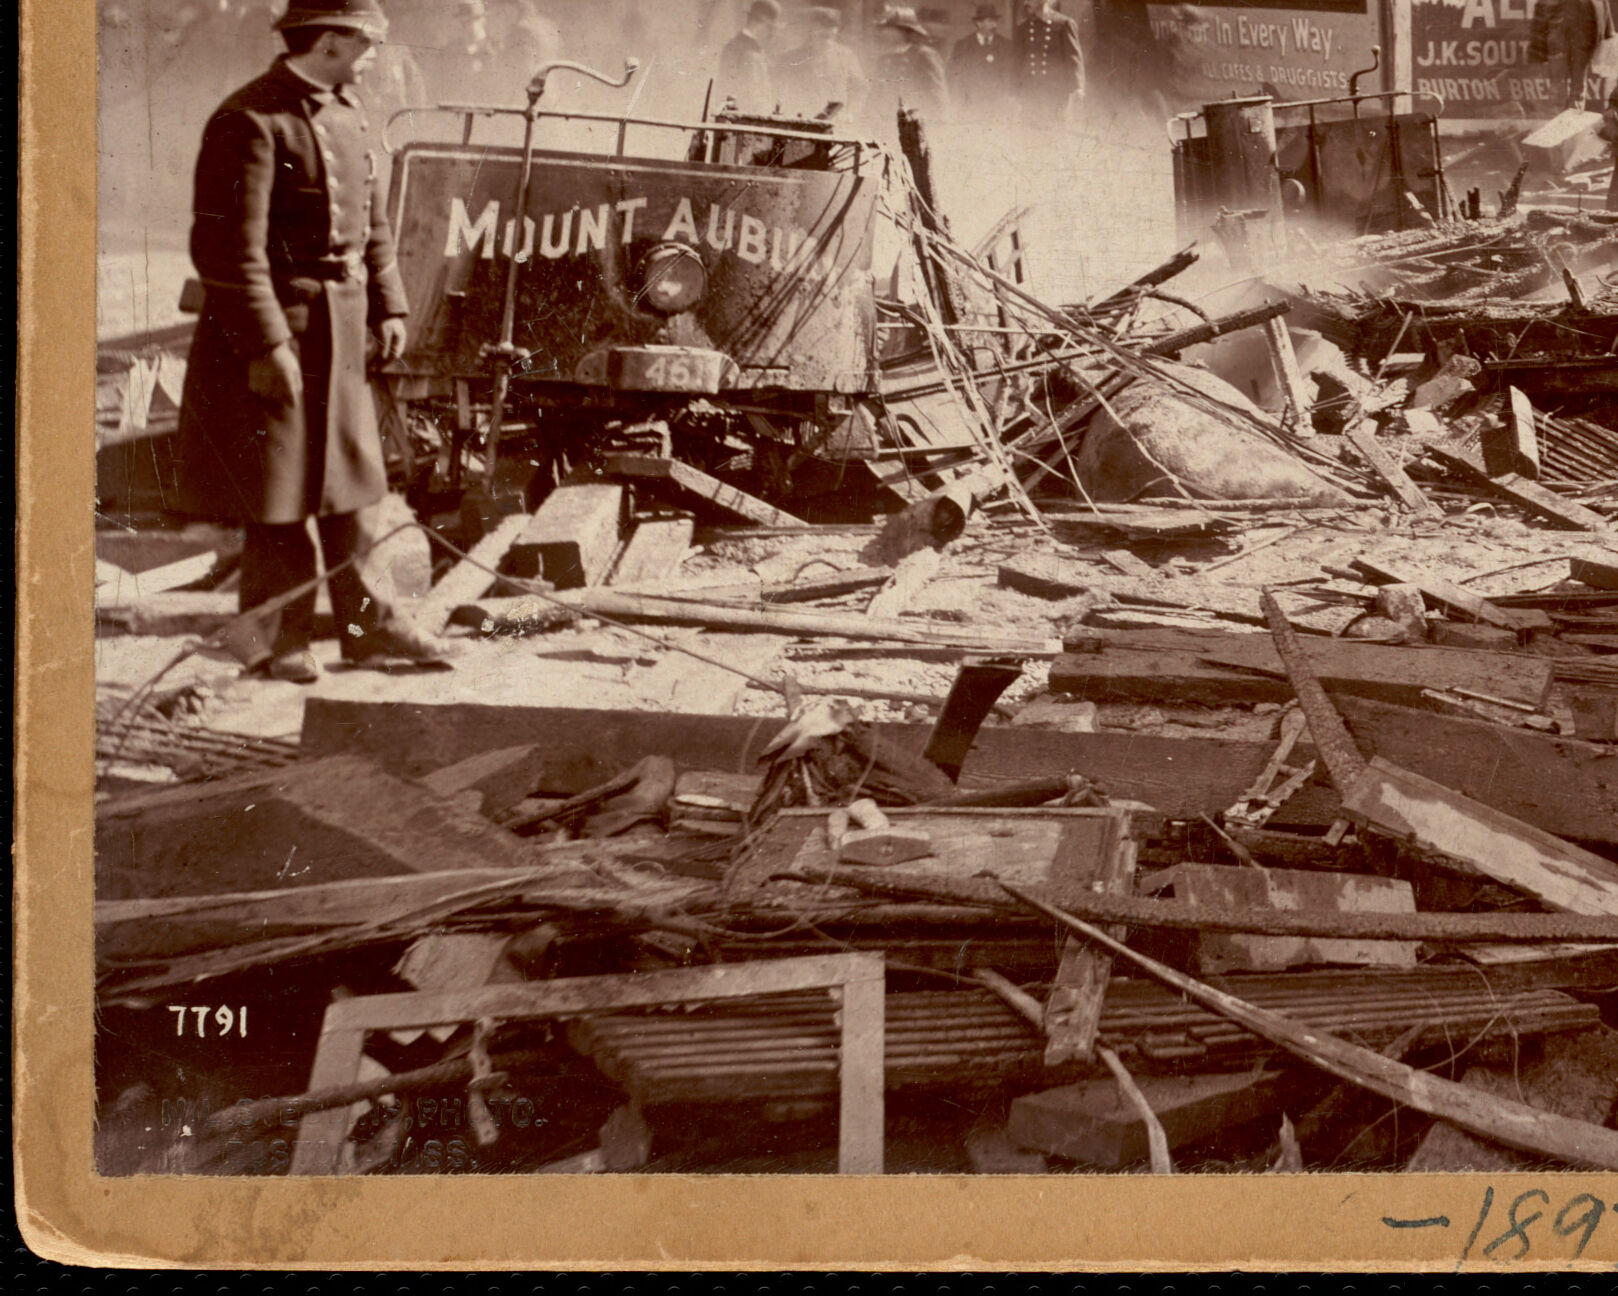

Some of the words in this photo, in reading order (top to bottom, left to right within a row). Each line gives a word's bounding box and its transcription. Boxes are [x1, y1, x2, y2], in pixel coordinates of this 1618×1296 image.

[1215, 14, 1233, 46] In
[1237, 14, 1289, 57] Every
[1465, 39, 1531, 67] SOUT
[1222, 62, 1255, 83] CAFES
[1256, 65, 1265, 83] &
[1269, 65, 1350, 90] DRUGGISTS
[1416, 76, 1501, 102] BURTON
[1509, 75, 1603, 102] BREY
[443, 196, 649, 261] MOUNT
[660, 196, 816, 277] AUBU
